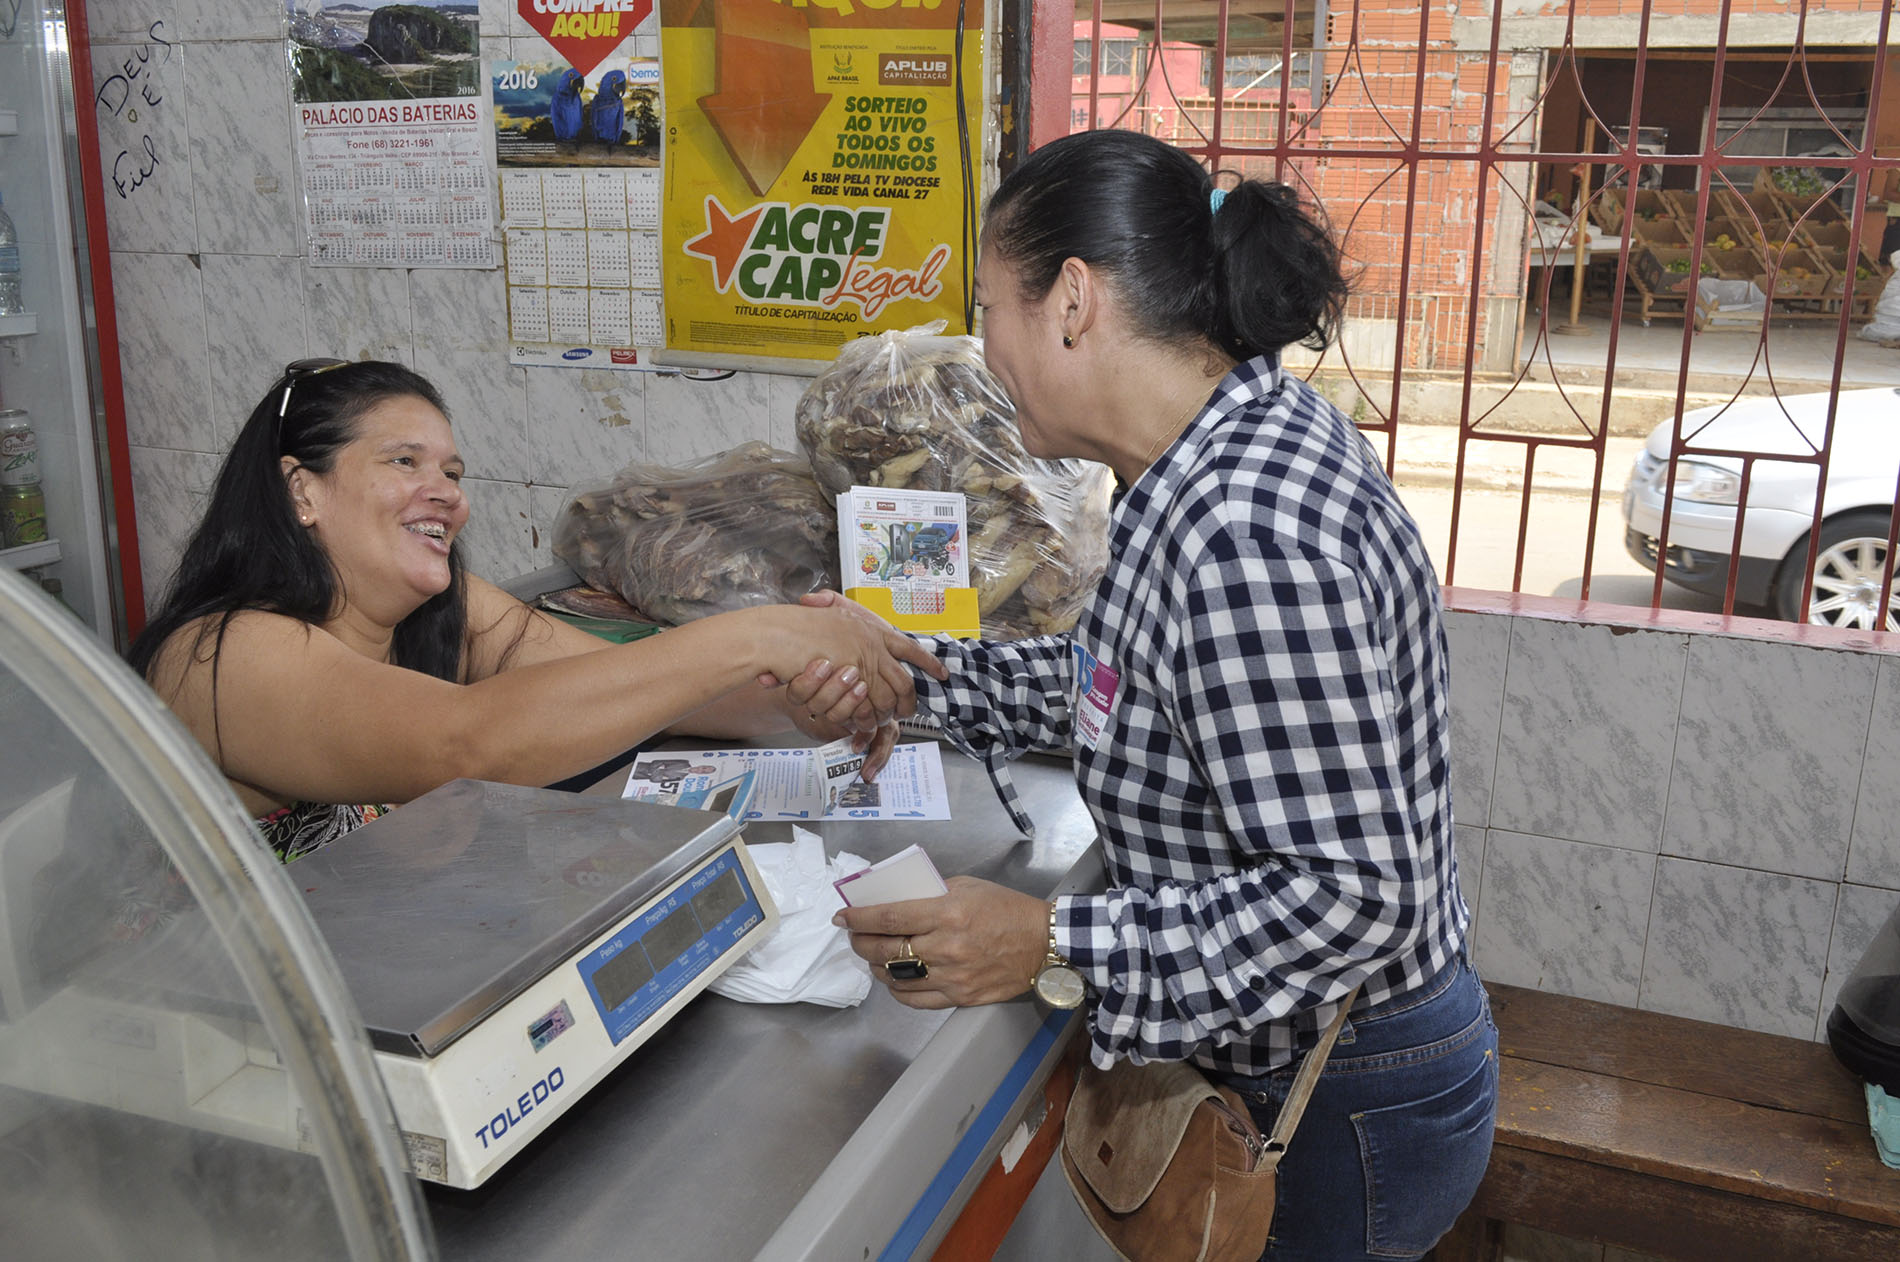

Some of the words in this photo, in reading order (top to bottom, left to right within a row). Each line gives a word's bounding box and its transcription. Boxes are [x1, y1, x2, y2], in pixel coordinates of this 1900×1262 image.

[550, 12, 620, 40] AQUI!
[95, 20, 172, 117] DEUS
[883, 72, 948, 80] CAPITALIZAÇÃO
[884, 60, 947, 72] APLUB
[500, 69, 538, 90] 2016
[457, 86, 476, 95] 2016
[302, 104, 364, 125] PALÁCIO
[367, 106, 399, 123] DAS
[402, 103, 477, 123] BATERIAS
[844, 96, 927, 114] SORTEIO
[844, 115, 872, 132] AO
[879, 116, 927, 133] VIVO
[347, 139, 369, 150] Fone
[371, 139, 388, 150] (68)
[390, 138, 434, 149] 3221-1961
[836, 134, 901, 151] TODOS
[907, 136, 935, 153] OS
[112, 134, 160, 199] Fiel
[832, 152, 937, 172] DOMINGOS
[802, 170, 817, 183] ÀS
[821, 173, 841, 184] 18H
[843, 174, 870, 185] PELA
[875, 175, 890, 186] TV
[893, 176, 940, 188] DIOCESE
[811, 184, 838, 196] REDE
[843, 186, 869, 197] VIDA
[873, 187, 910, 199] CANAL
[913, 189, 929, 200] 27
[750, 206, 886, 256] ACRE
[738, 253, 841, 301] CAP
[822, 246, 947, 318] Legal
[734, 305, 770, 318] TÍTULO
[770, 308, 782, 319] DE
[783, 309, 857, 323] CAPITALIZAÇÃO
[827, 759, 862, 779] 15789
[732, 914, 757, 939] TOLEDO
[599, 944, 615, 959] Peso
[613, 939, 623, 951] kg
[475, 1066, 565, 1148] TOLEDO
